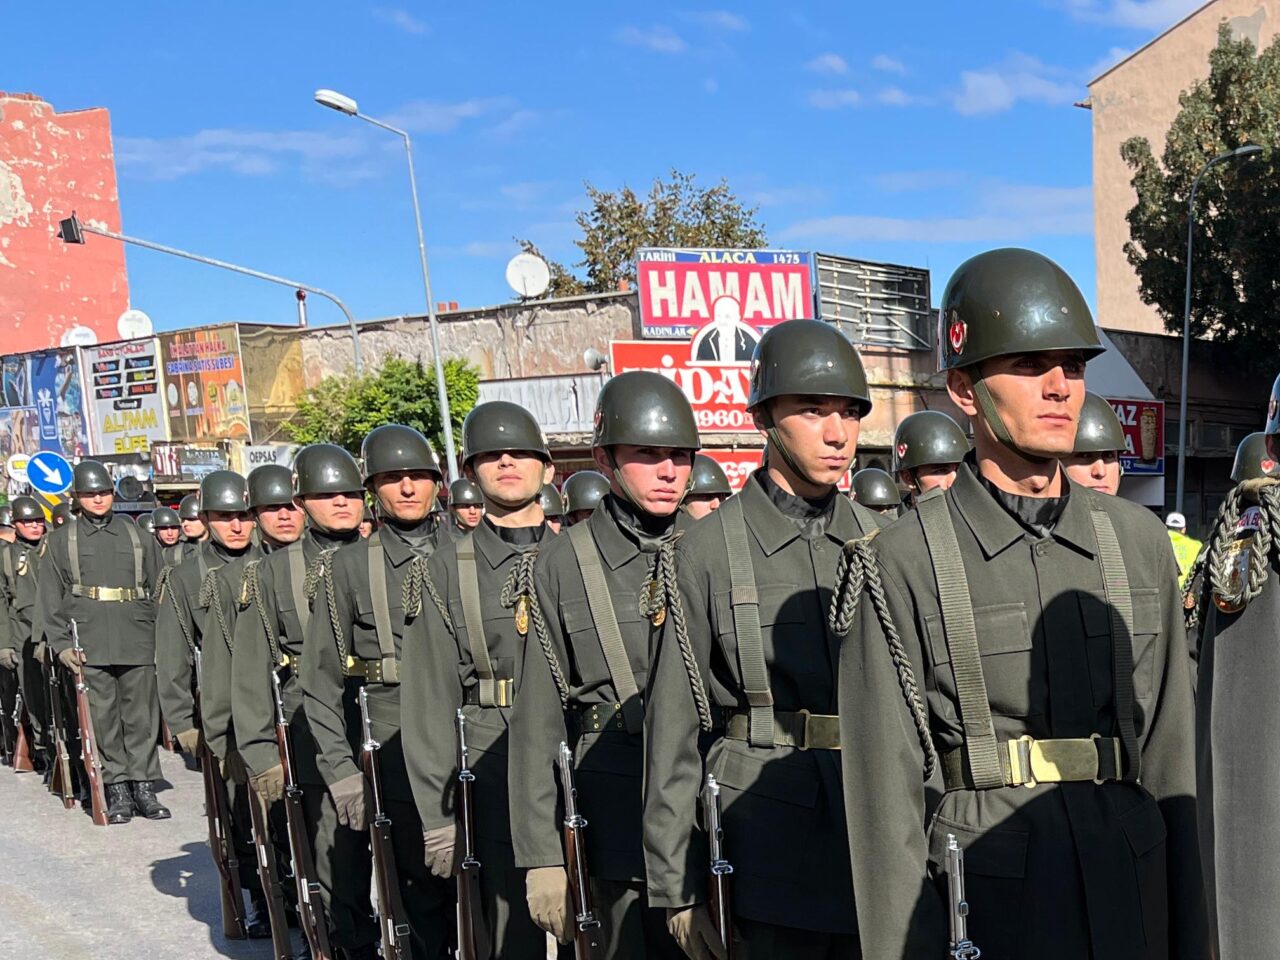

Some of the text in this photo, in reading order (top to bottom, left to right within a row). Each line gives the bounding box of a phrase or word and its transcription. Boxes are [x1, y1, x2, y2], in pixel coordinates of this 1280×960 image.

[699, 252, 757, 264] ALACA
[773, 254, 800, 264] 1475
[648, 270, 804, 320] HAMAM
[643, 326, 686, 337] KADINLAR
[696, 411, 743, 427] 1960
